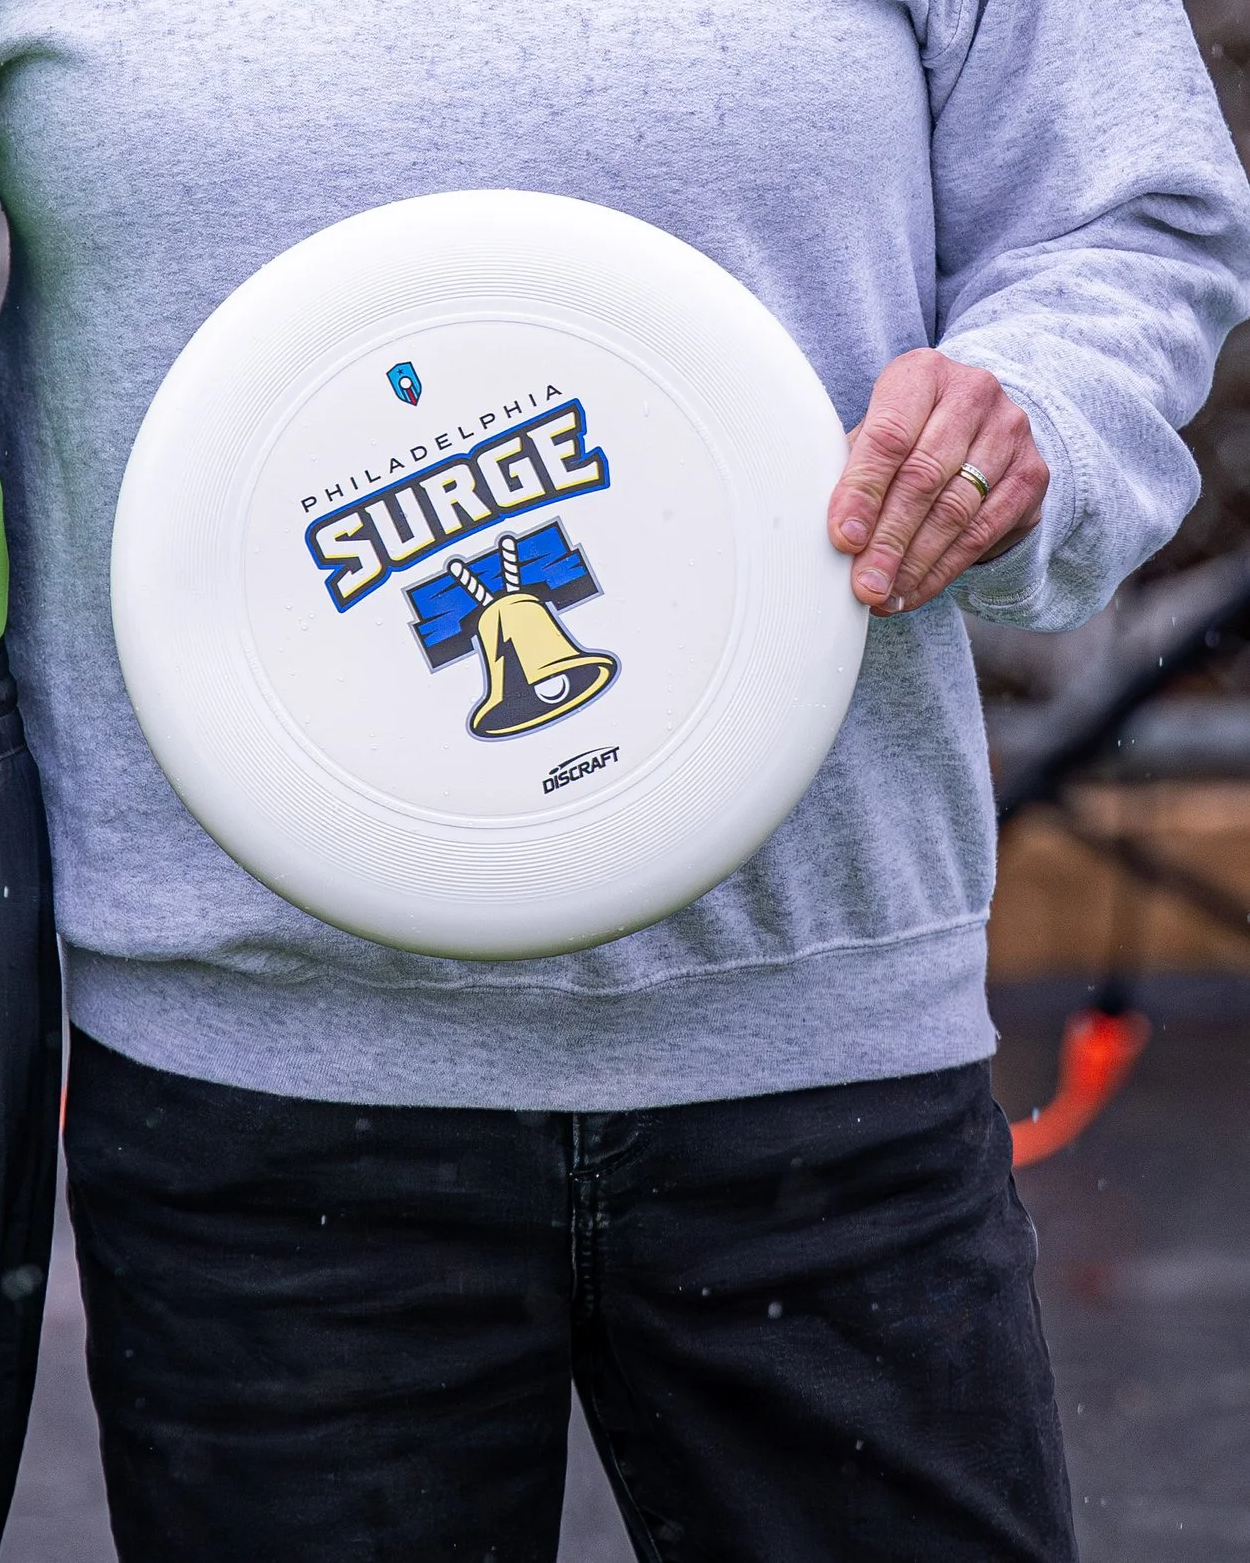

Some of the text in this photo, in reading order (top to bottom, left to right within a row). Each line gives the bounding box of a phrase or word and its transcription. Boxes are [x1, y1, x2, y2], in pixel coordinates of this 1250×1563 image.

[301, 384, 563, 514] PHILADELPHIA
[311, 406, 604, 605] SURGE
[542, 746, 620, 795] DISCRAFT
